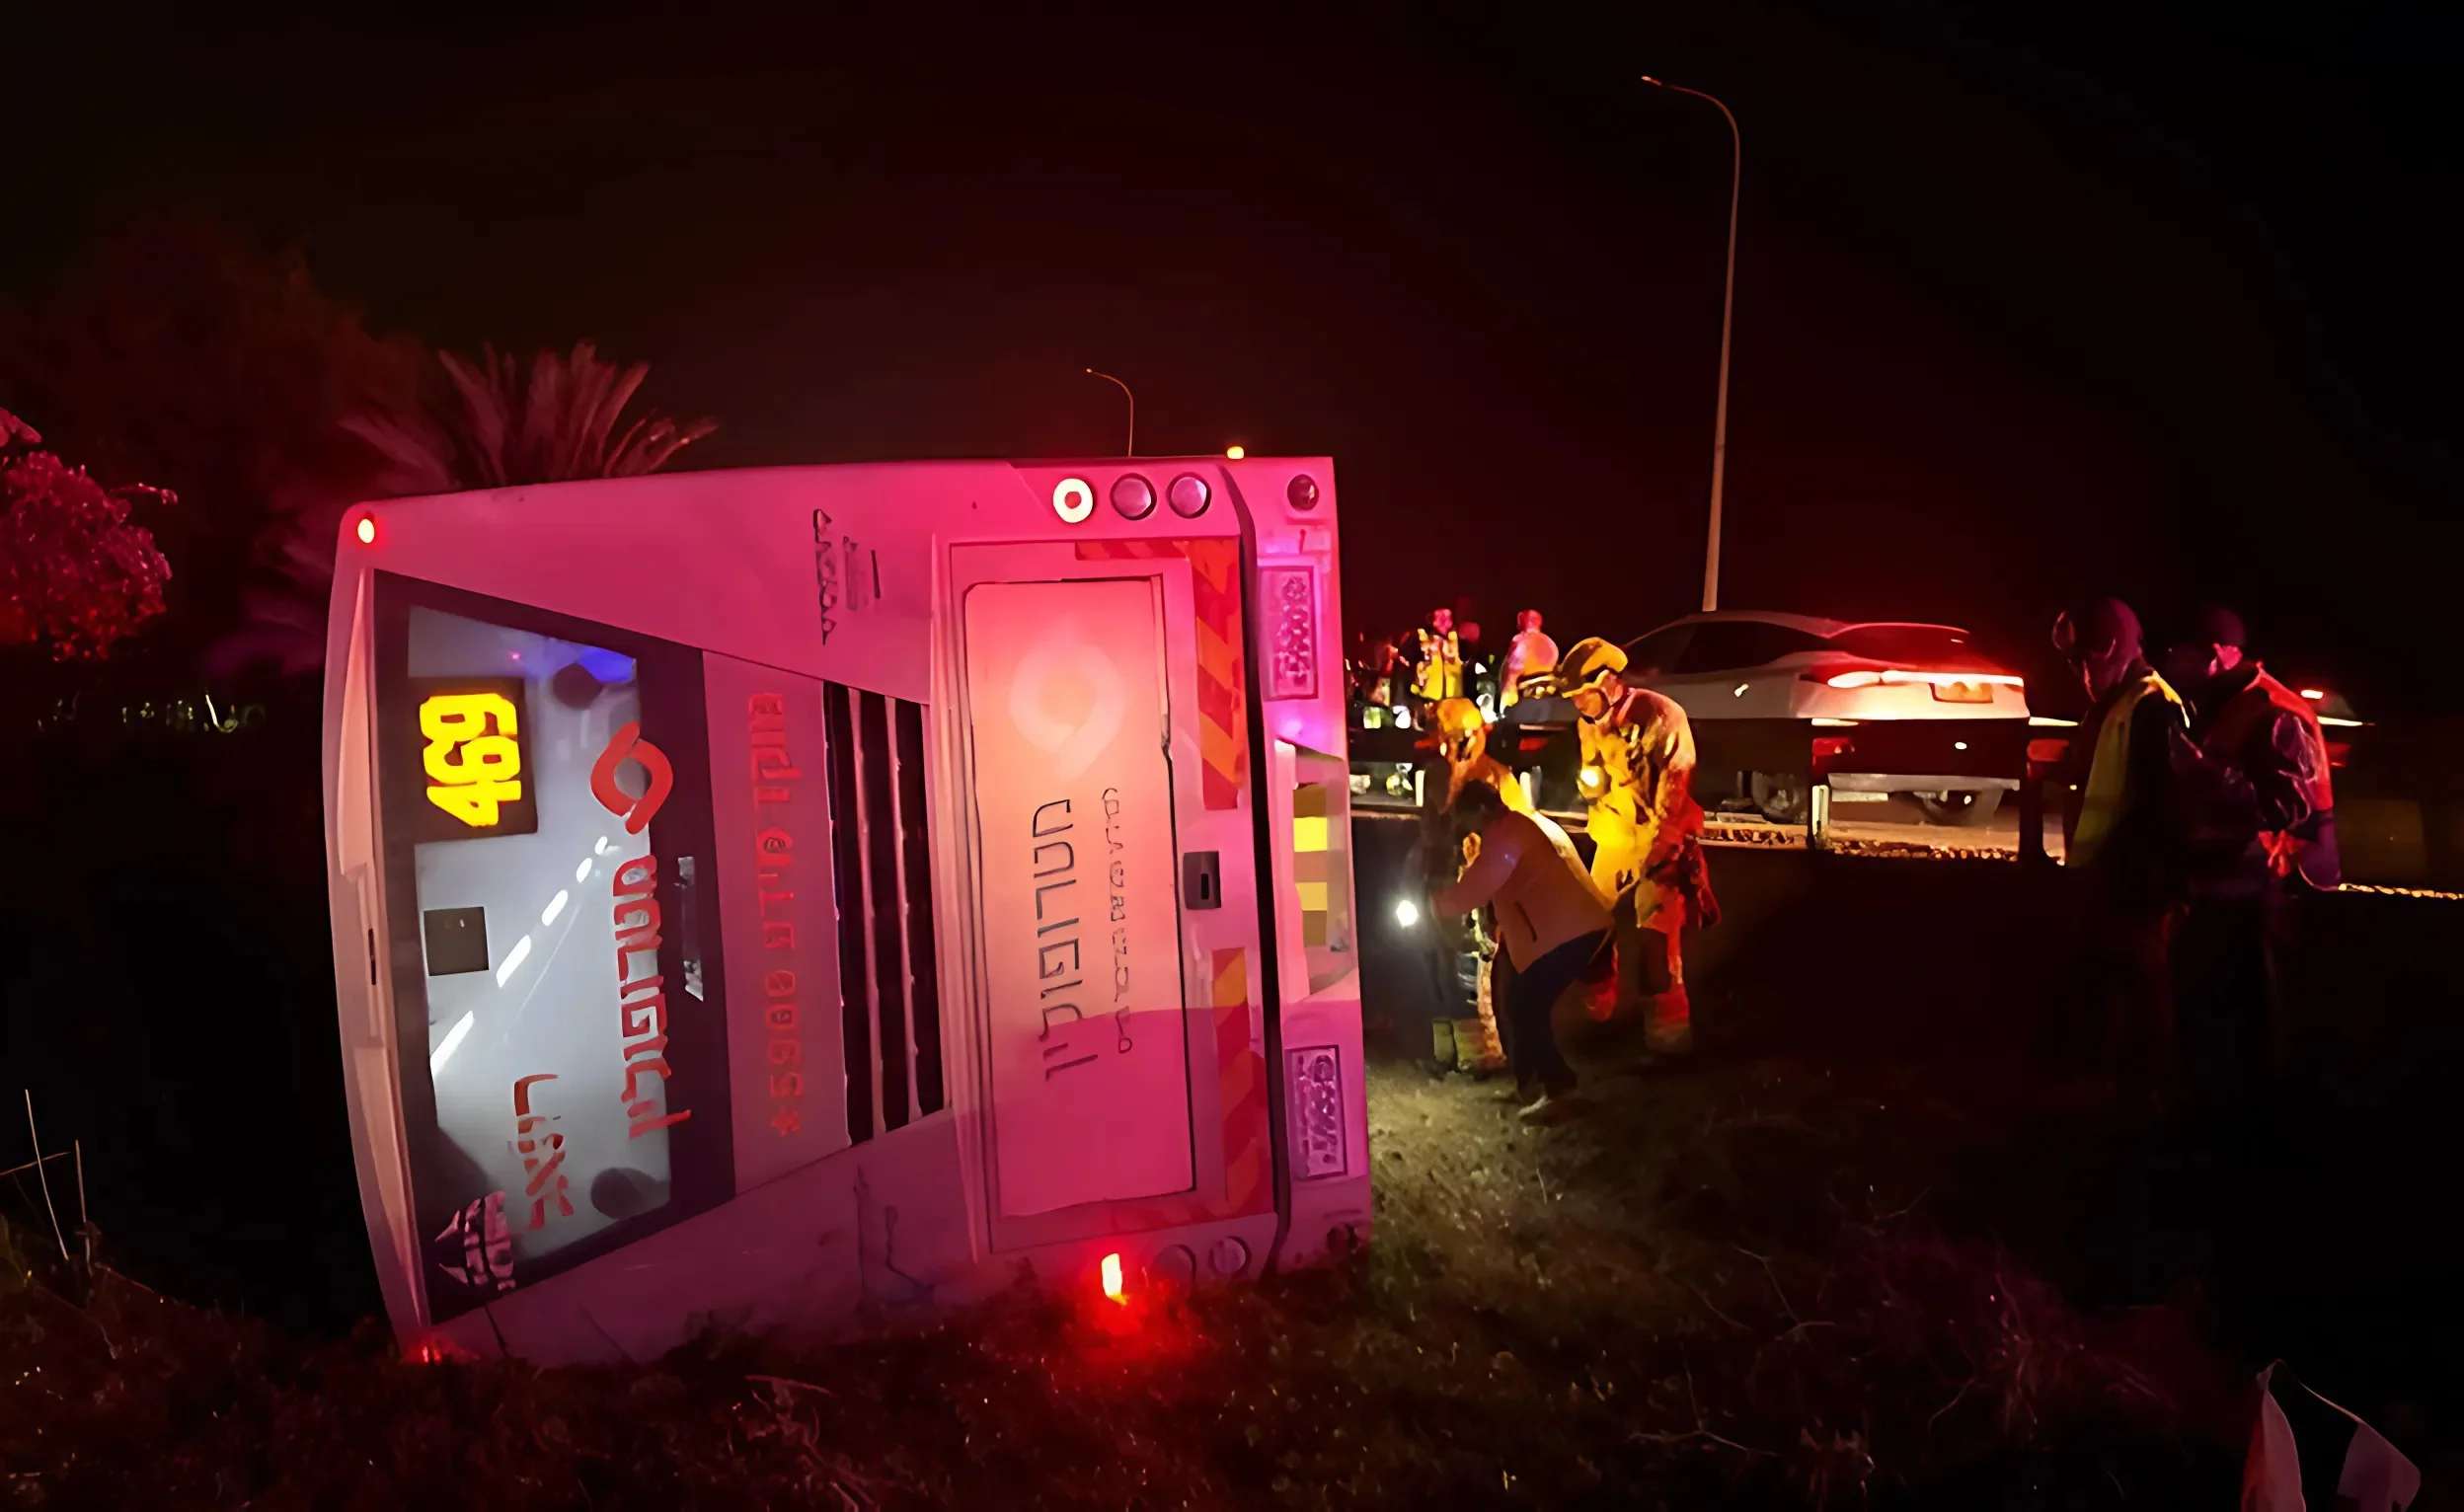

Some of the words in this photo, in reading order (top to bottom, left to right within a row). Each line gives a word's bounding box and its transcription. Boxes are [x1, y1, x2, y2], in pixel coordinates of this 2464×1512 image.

[420, 693, 521, 827] 469
[612, 854, 692, 1140] מטרופולין
[1032, 797, 1099, 1083] מטרופולין
